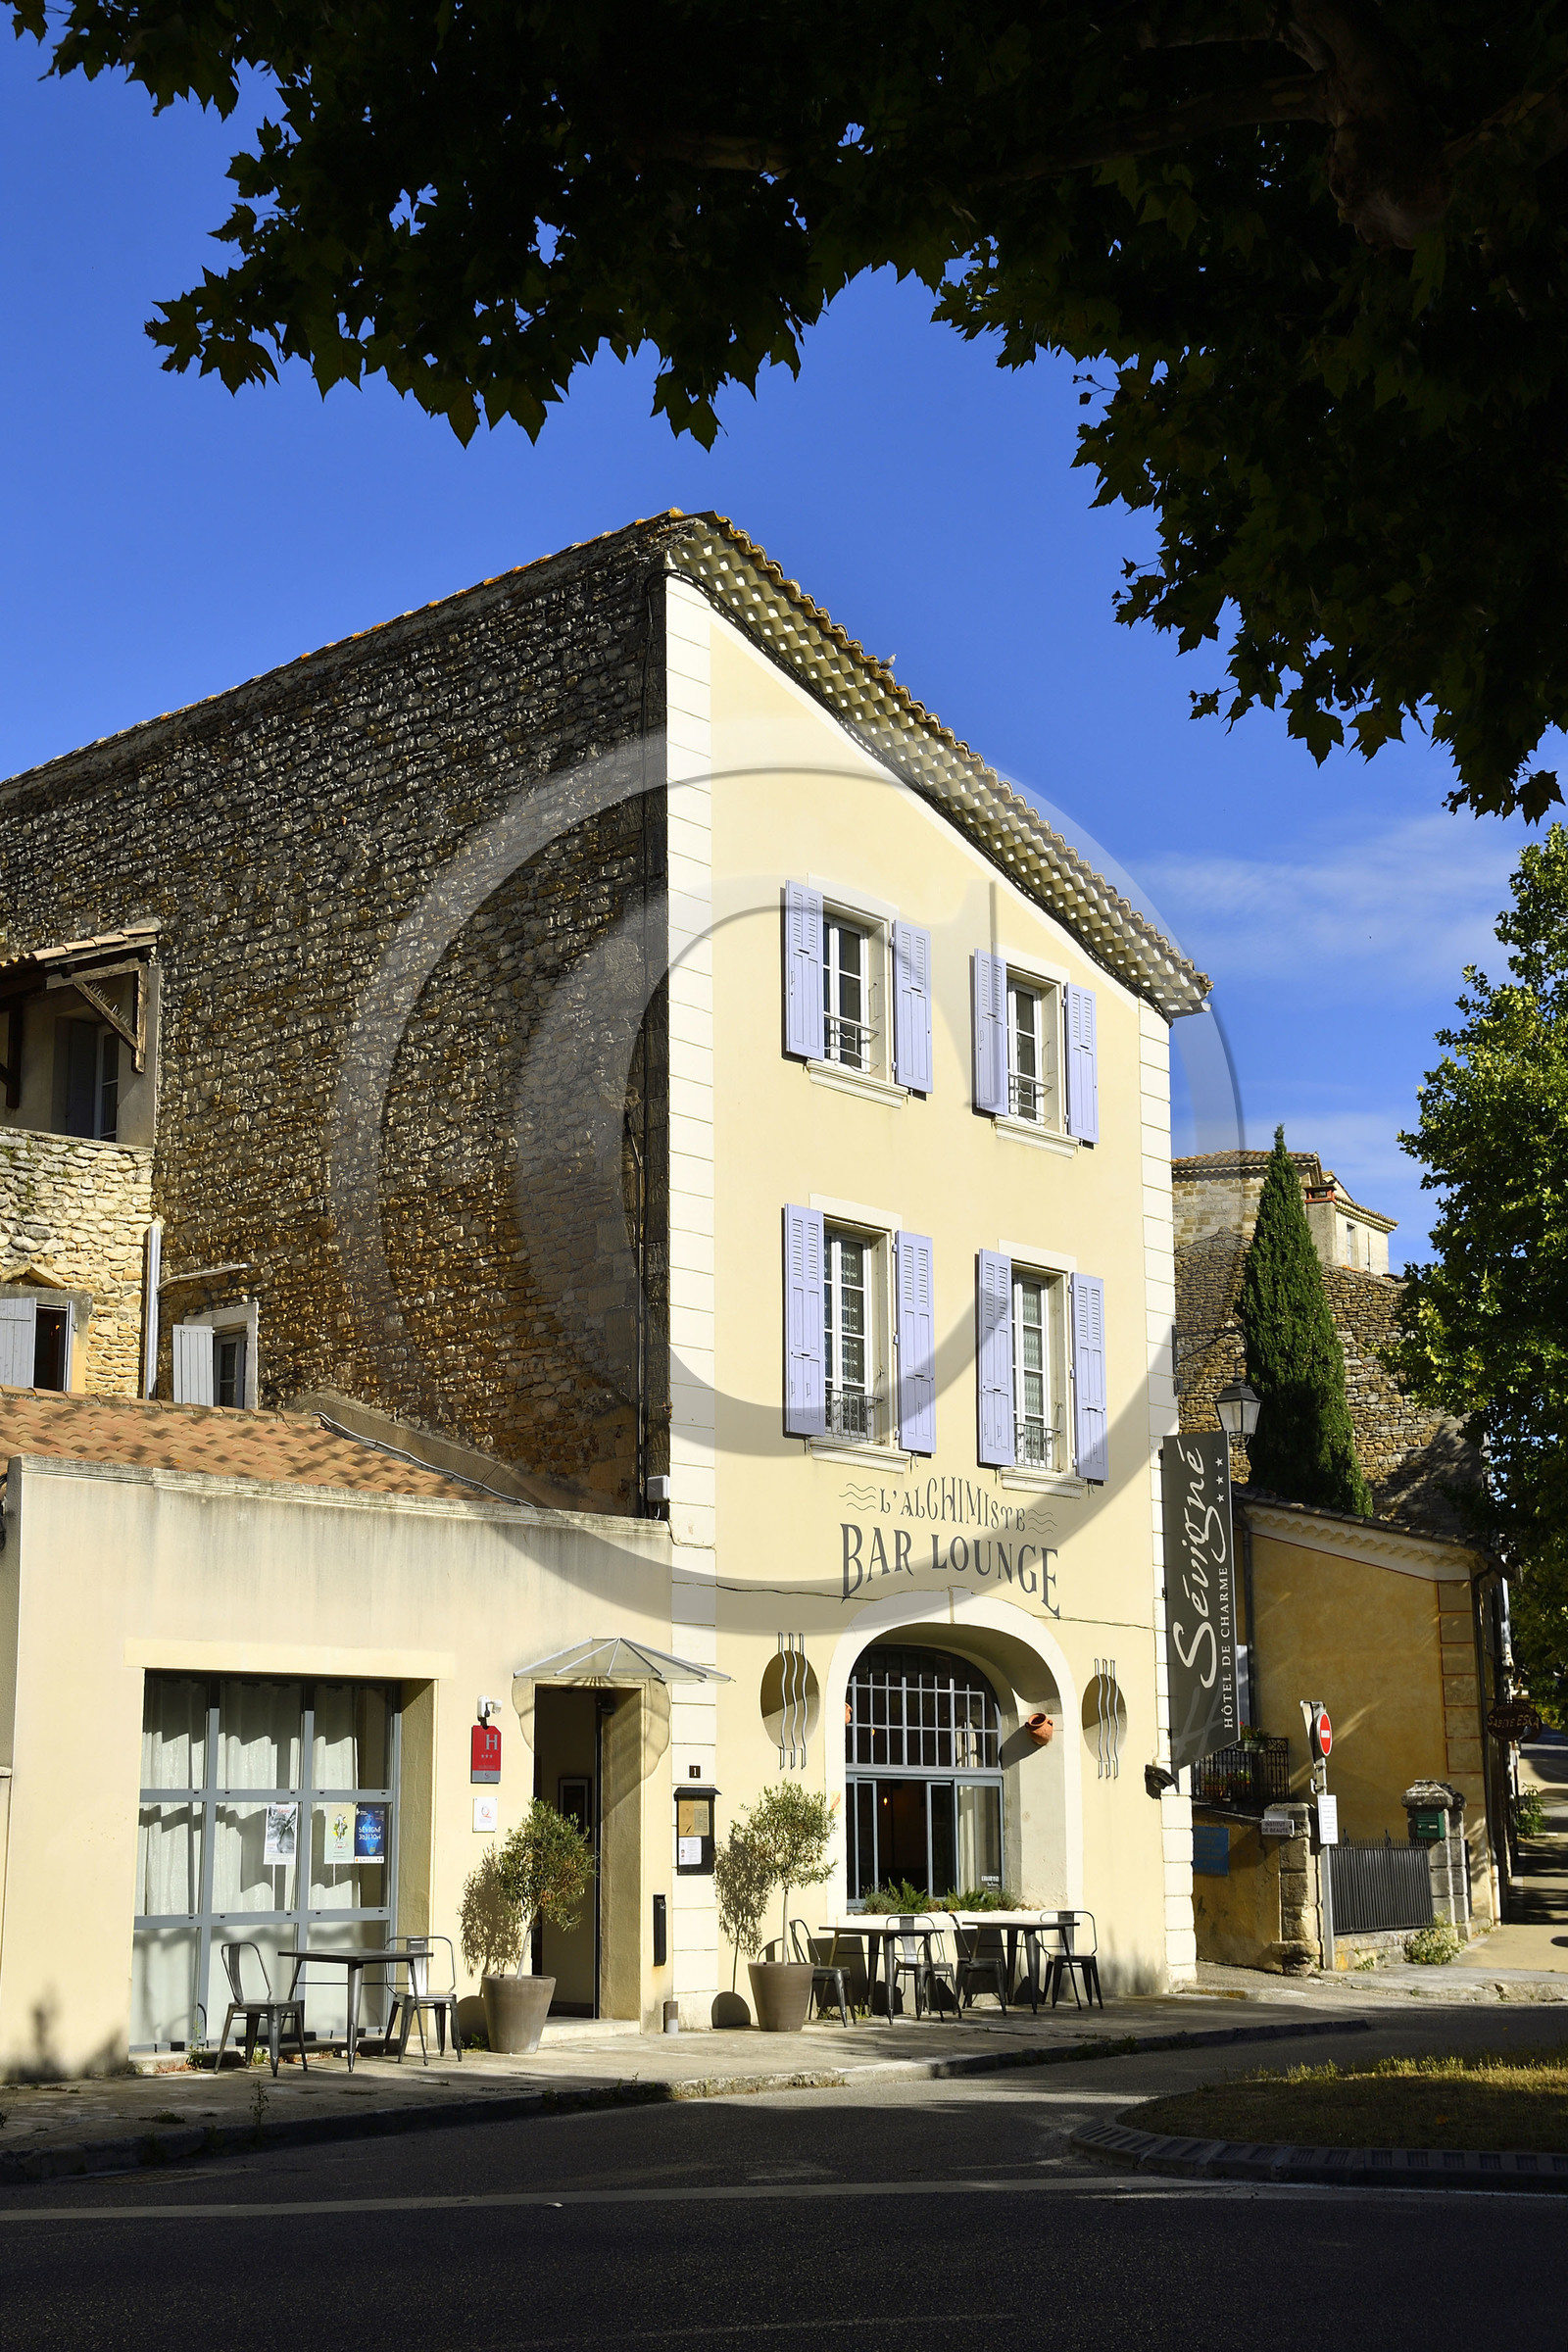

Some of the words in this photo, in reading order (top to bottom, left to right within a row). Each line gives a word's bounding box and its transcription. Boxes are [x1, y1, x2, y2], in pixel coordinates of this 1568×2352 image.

[840, 1523, 914, 1604] BAR
[930, 1534, 1061, 1619] LOUNGE
[1173, 1439, 1226, 1689] Sévigné
[1218, 1567, 1231, 1639] CHARME
[1221, 1644, 1232, 1666] DE
[1222, 1673, 1234, 1729] HÔTEL
[485, 1734, 499, 1750] H
[693, 1767, 697, 1777] 1
